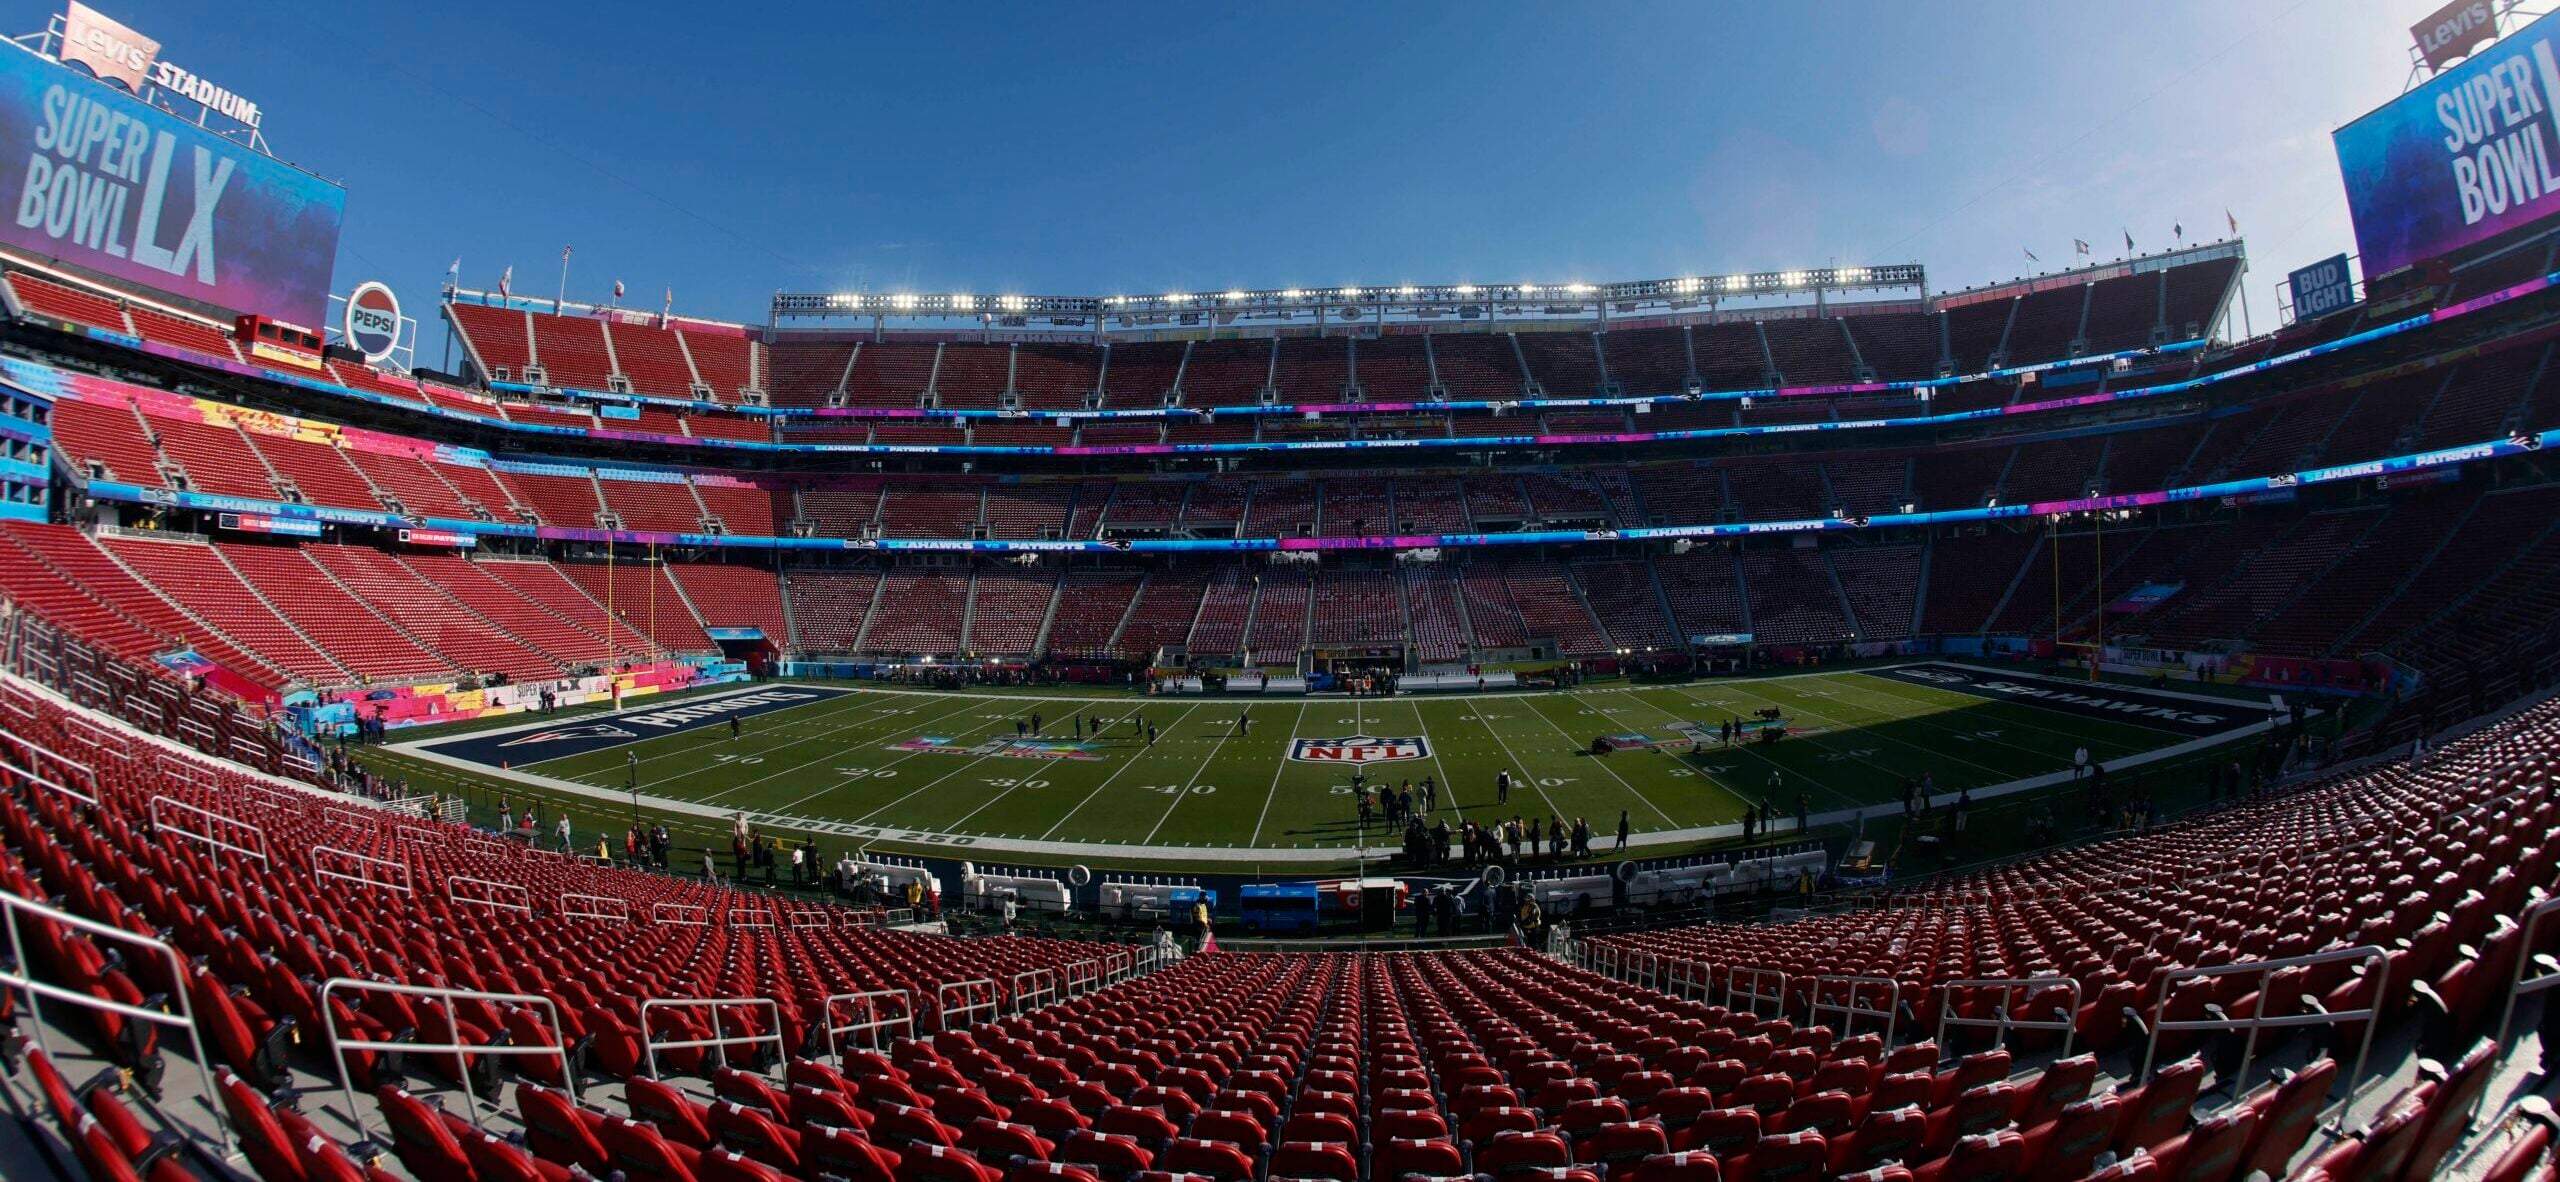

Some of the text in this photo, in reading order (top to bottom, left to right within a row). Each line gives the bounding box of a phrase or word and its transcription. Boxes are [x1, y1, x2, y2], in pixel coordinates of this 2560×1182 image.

[71, 22, 147, 72] Levi's
[156, 62, 259, 127] STADIUM
[2435, 54, 2544, 154] SUPER
[36, 85, 149, 184] SUPER
[2452, 122, 2560, 226] BOWL
[16, 152, 129, 259] BOWL
[131, 129, 238, 287] LX
[2300, 264, 2338, 292] BUD
[2295, 281, 2348, 315] LIGHT
[354, 309, 395, 334] PEPSI
[1002, 316, 1026, 326] VISA
[990, 333, 1094, 343] SEAHAWKS
[1534, 399, 1588, 407] SEAHAWKS
[1607, 396, 1655, 405] PATRIOTS
[1117, 409, 1166, 417] PATRIOTS
[1287, 441, 1346, 449] SEAHAWKS
[1367, 439, 1419, 447] PATRIOTS
[2304, 461, 2384, 483] SEAHAWKS
[2415, 447, 2494, 467] PATRIOTS
[190, 494, 281, 514] SEAHAWKS
[315, 509, 388, 525] PATRIOTS
[259, 520, 320, 533] SEAHAWKS
[1628, 527, 1714, 538] SEAHAWKS
[1749, 521, 1825, 533] PATRIOTS
[434, 533, 477, 545] PATRIOTS
[887, 540, 974, 551] SEAHAWKS
[1008, 540, 1085, 551] PATRIOTS
[1319, 536, 1396, 549] SUPER BOWL LX
[517, 683, 538, 698] SUPER
[557, 678, 582, 692] LX
[617, 691, 819, 728] PATRIOTS
[1970, 682, 2226, 724] SEAHAWKS
[1306, 746, 1414, 761] NFL
[1668, 766, 1729, 777] 30
[988, 778, 1050, 791] 30
[1145, 784, 1217, 795] 40
[900, 832, 977, 846] 250
